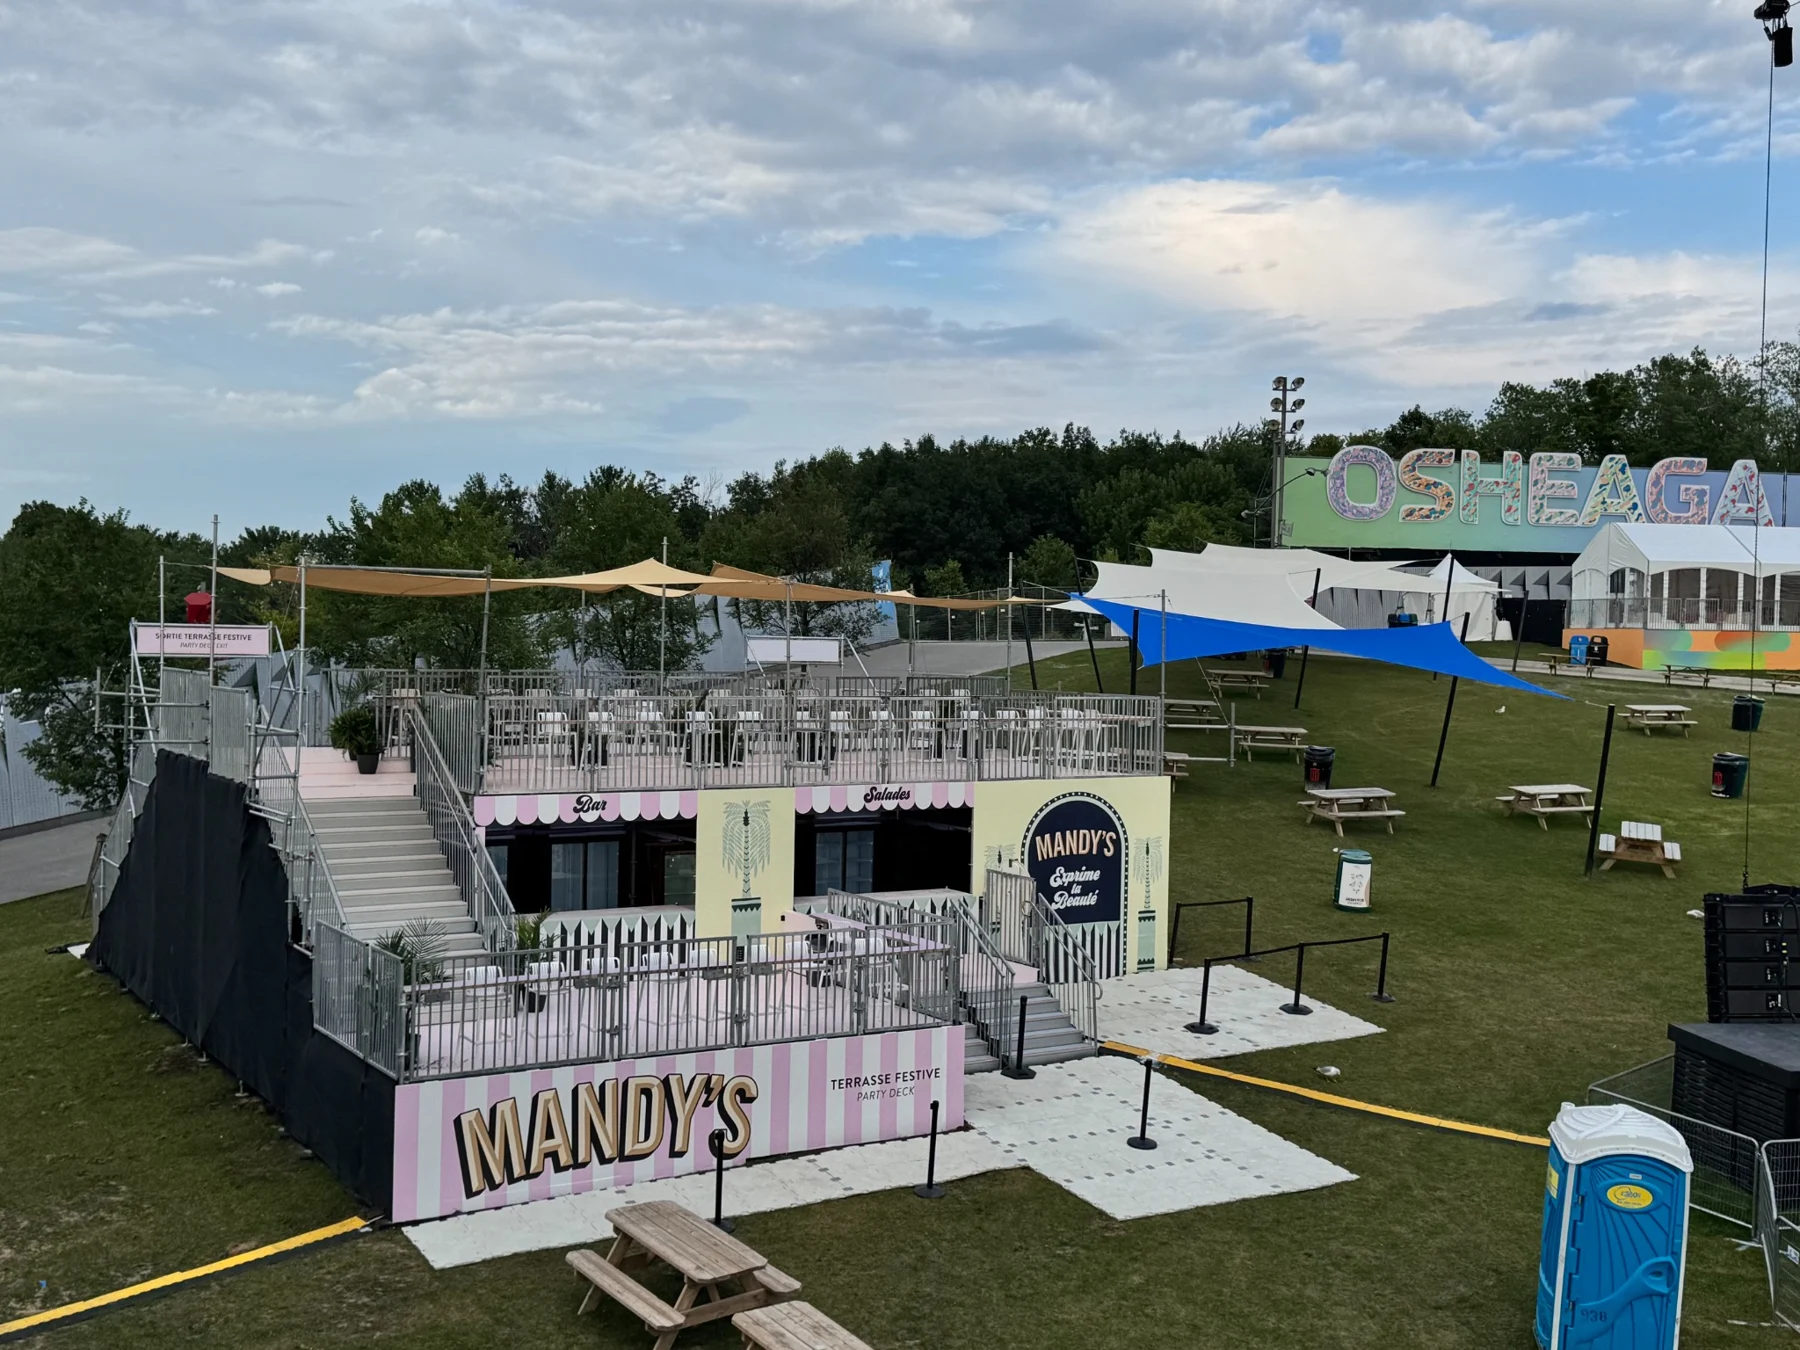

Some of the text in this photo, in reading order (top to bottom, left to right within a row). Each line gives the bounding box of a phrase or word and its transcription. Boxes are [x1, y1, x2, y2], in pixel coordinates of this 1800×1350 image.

[1325, 445, 1775, 527] OSHEAGA
[573, 794, 607, 814] Bar
[863, 786, 911, 803] Salades
[1035, 829, 1117, 862] MANDY'S
[1049, 866, 1101, 888] Exprime
[1071, 883, 1082, 894] la
[1051, 889, 1099, 910] Beauté
[830, 1067, 941, 1091] TERRASSE FESTIVE
[856, 1085, 916, 1102] PARTY DECK
[453, 1073, 758, 1199] MANDY'S
